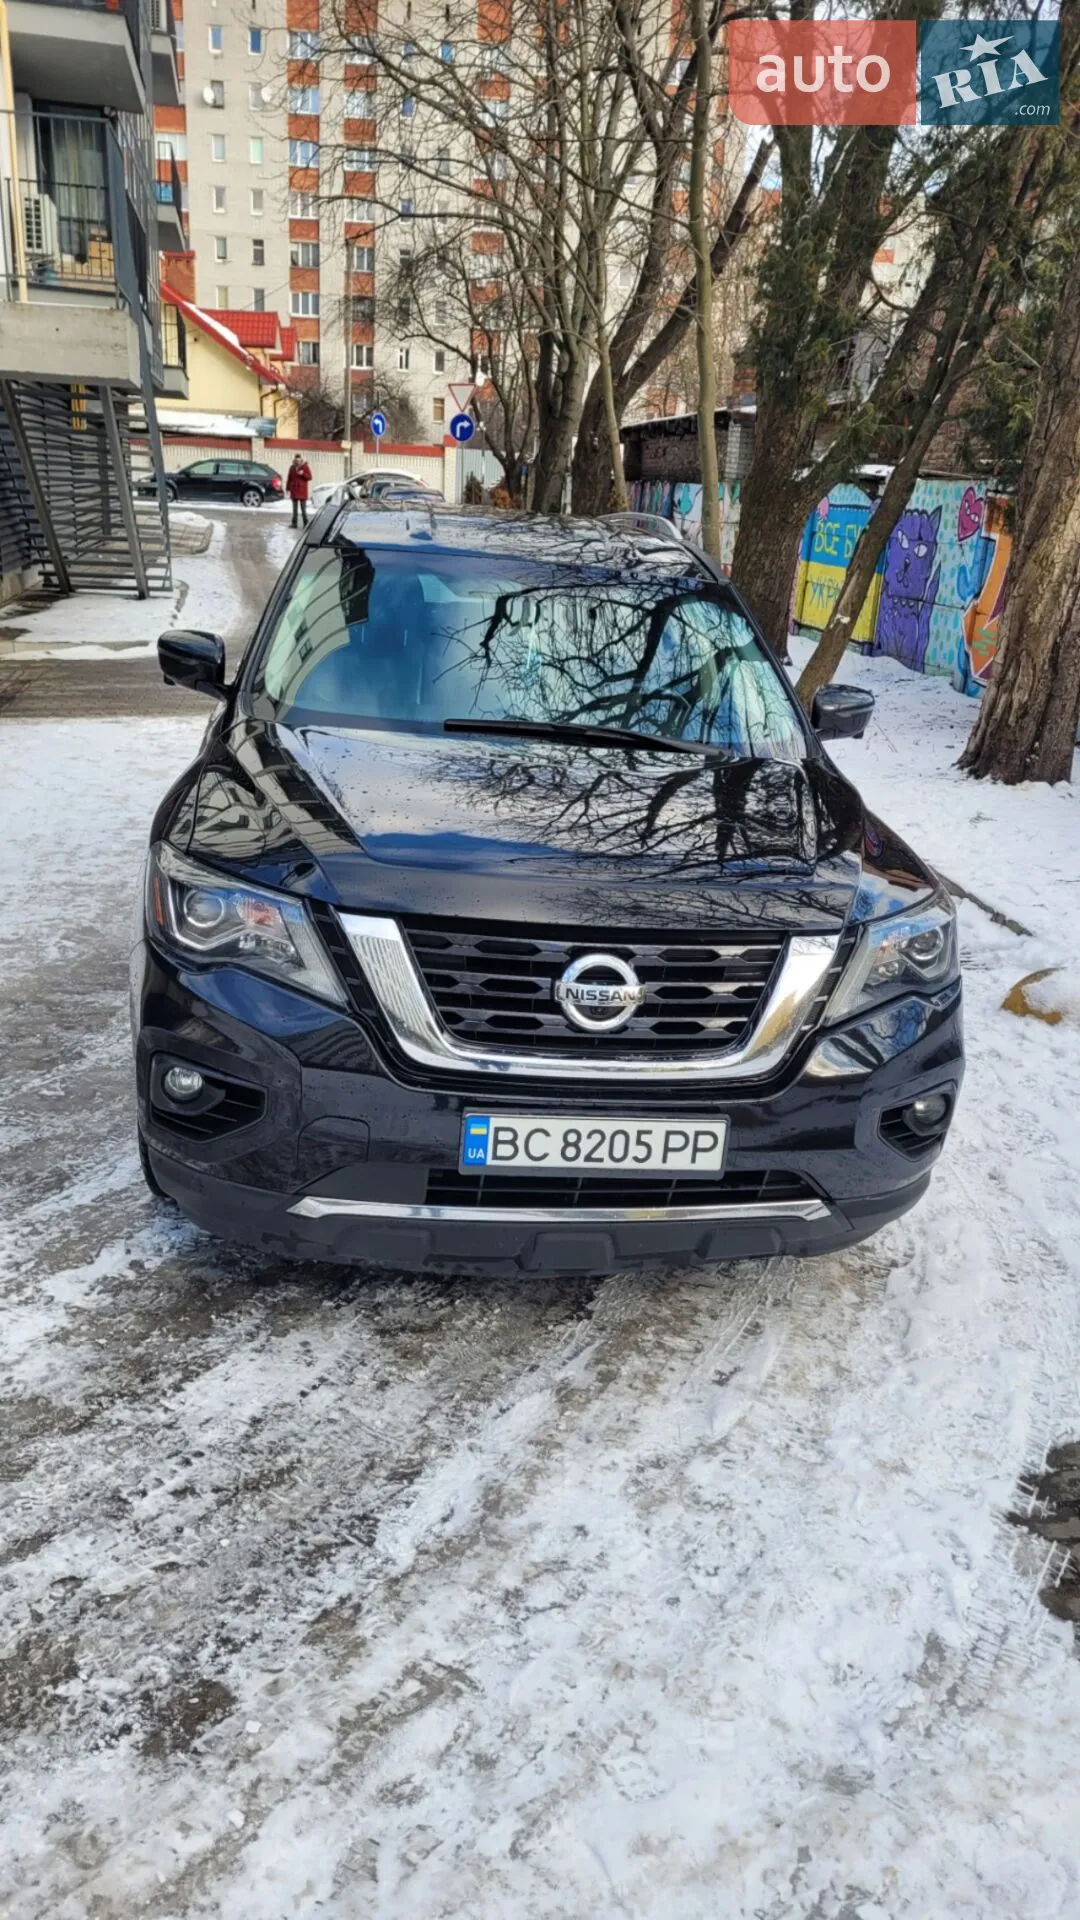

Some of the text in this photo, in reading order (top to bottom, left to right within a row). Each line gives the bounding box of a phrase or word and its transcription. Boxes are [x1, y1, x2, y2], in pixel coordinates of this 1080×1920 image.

[814, 518, 869, 559] ВСЕ БУ
[565, 988, 636, 1001] NISSAN
[467, 1126, 719, 1164] UA BC 8205 PP
